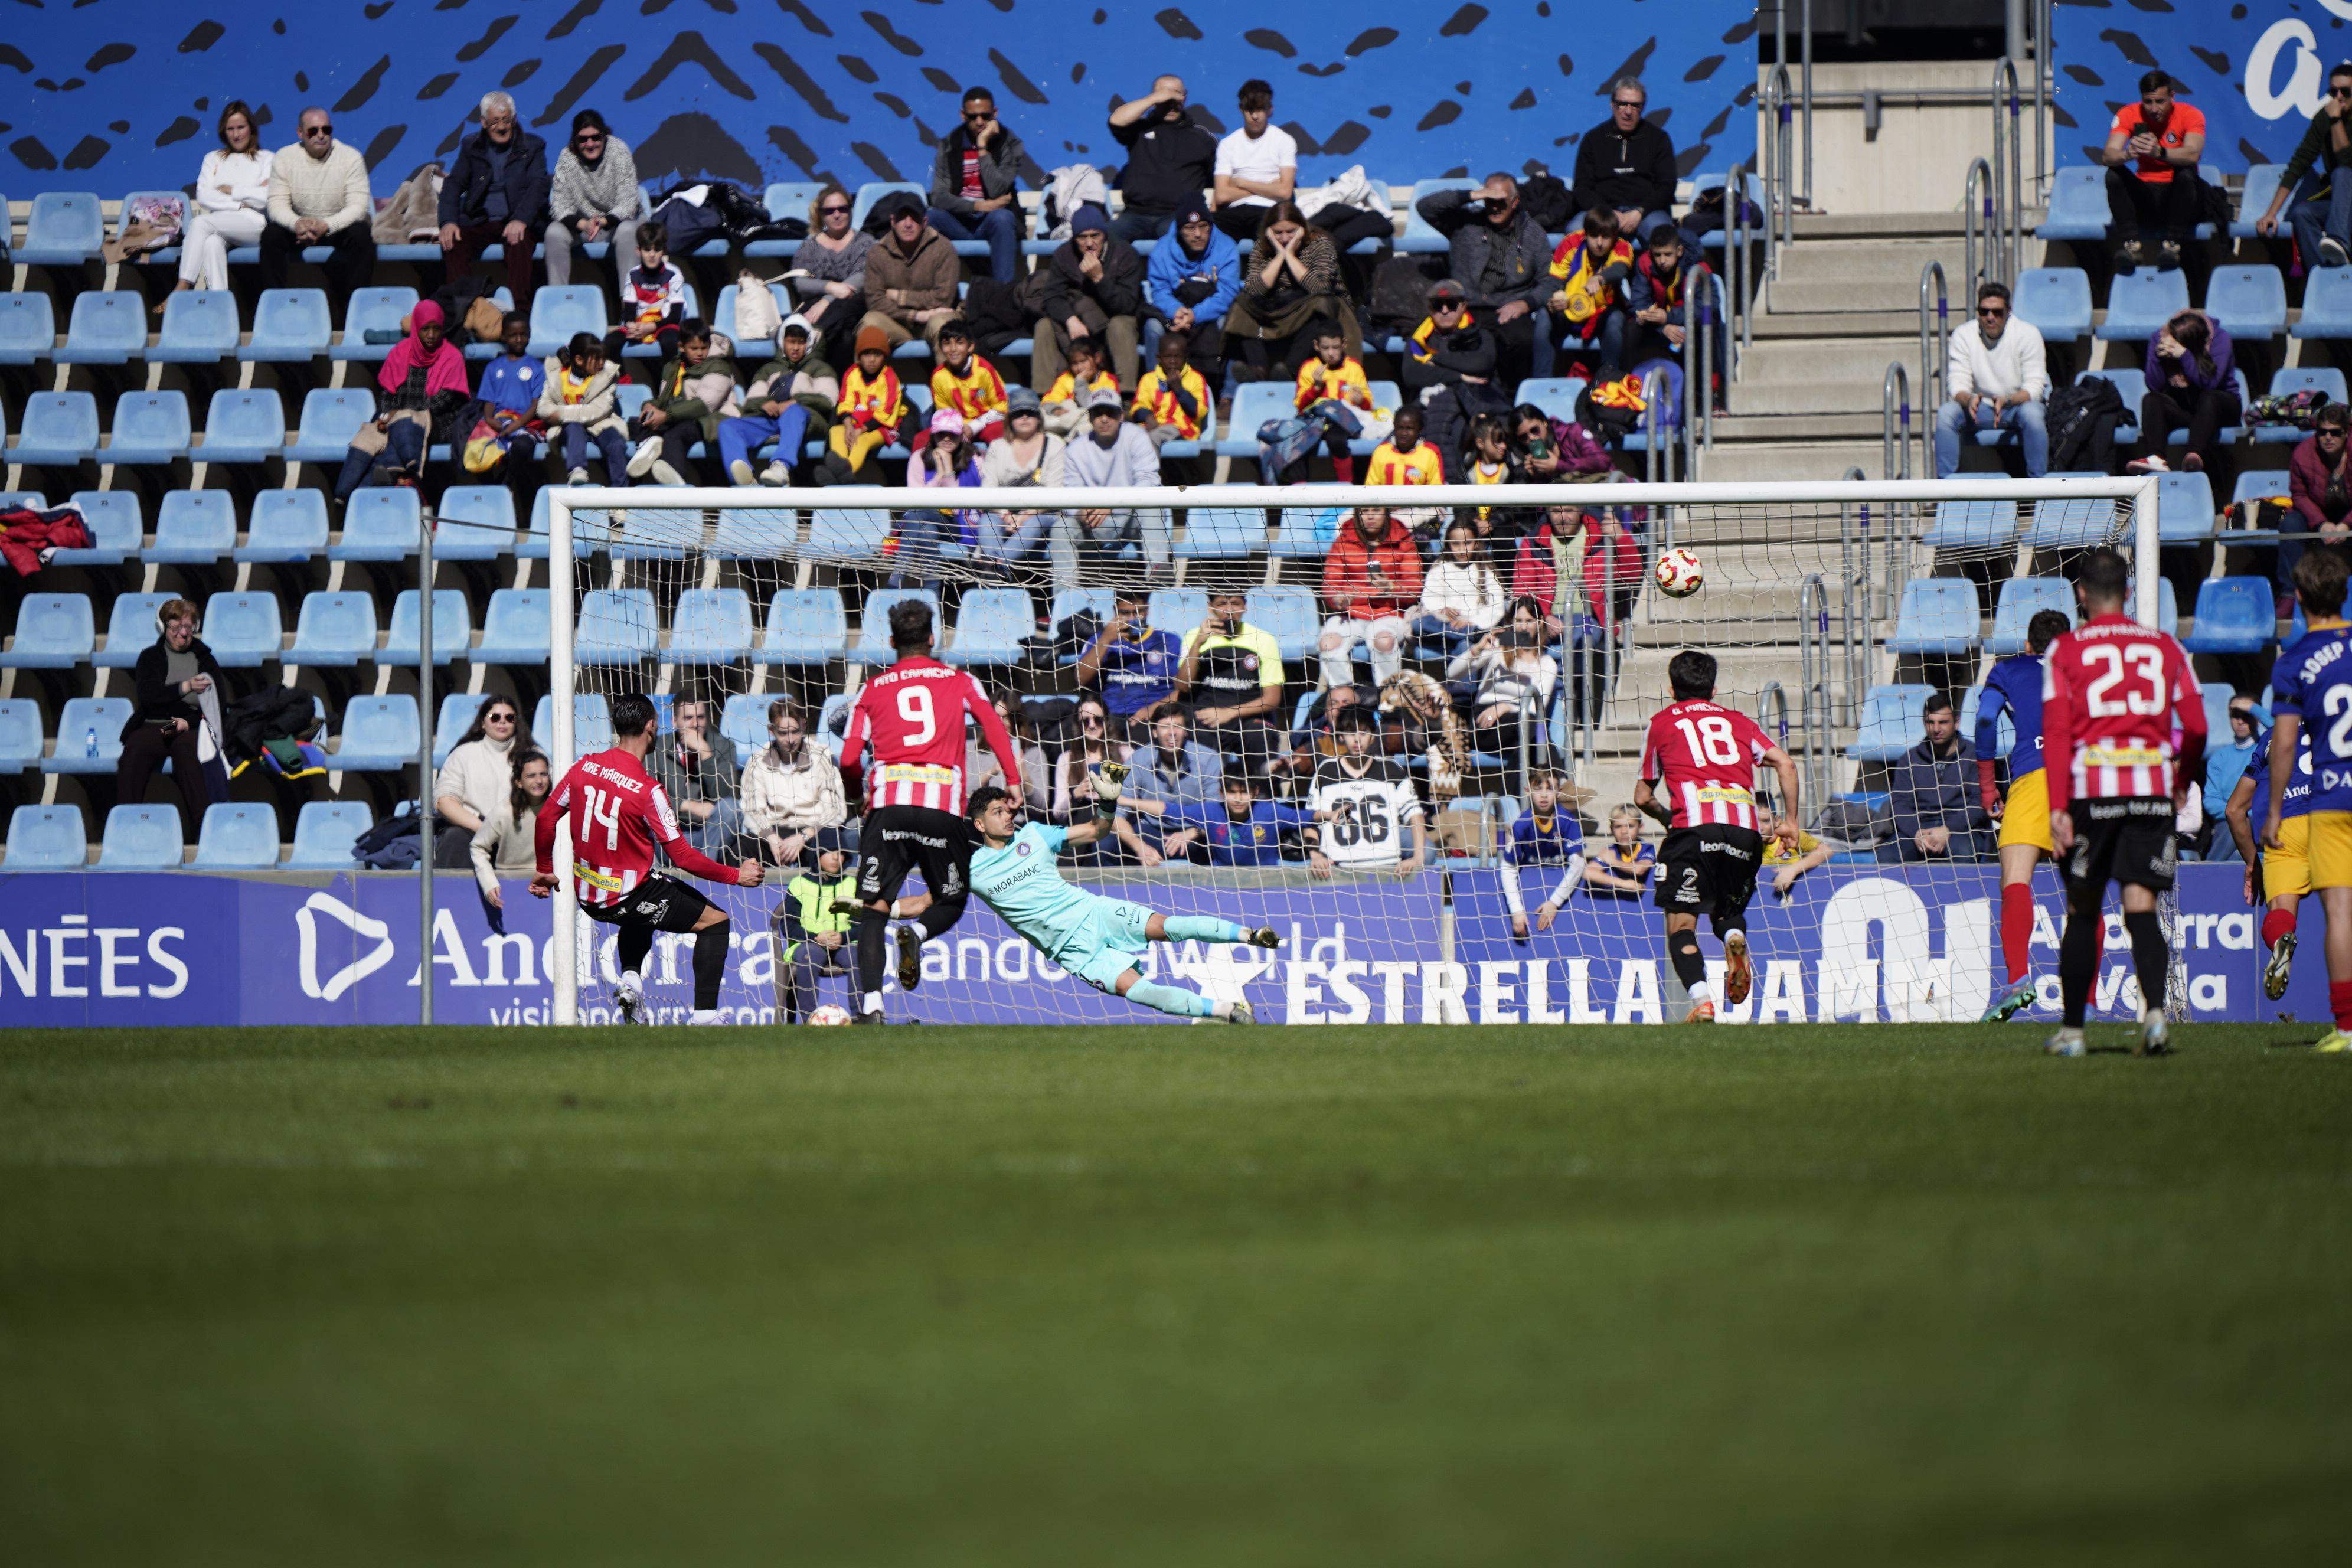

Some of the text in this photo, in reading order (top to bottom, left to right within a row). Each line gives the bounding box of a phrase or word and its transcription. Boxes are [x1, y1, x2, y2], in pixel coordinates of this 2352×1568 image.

[2081, 643, 2166, 719] 23
[2299, 641, 2344, 684] JOSEP
[897, 685, 936, 747] 9
[1674, 716, 1740, 768] 18
[582, 785, 622, 851] 14
[994, 864, 1041, 894] MORABANC
[1285, 959, 1664, 1025] ESTRELLA
